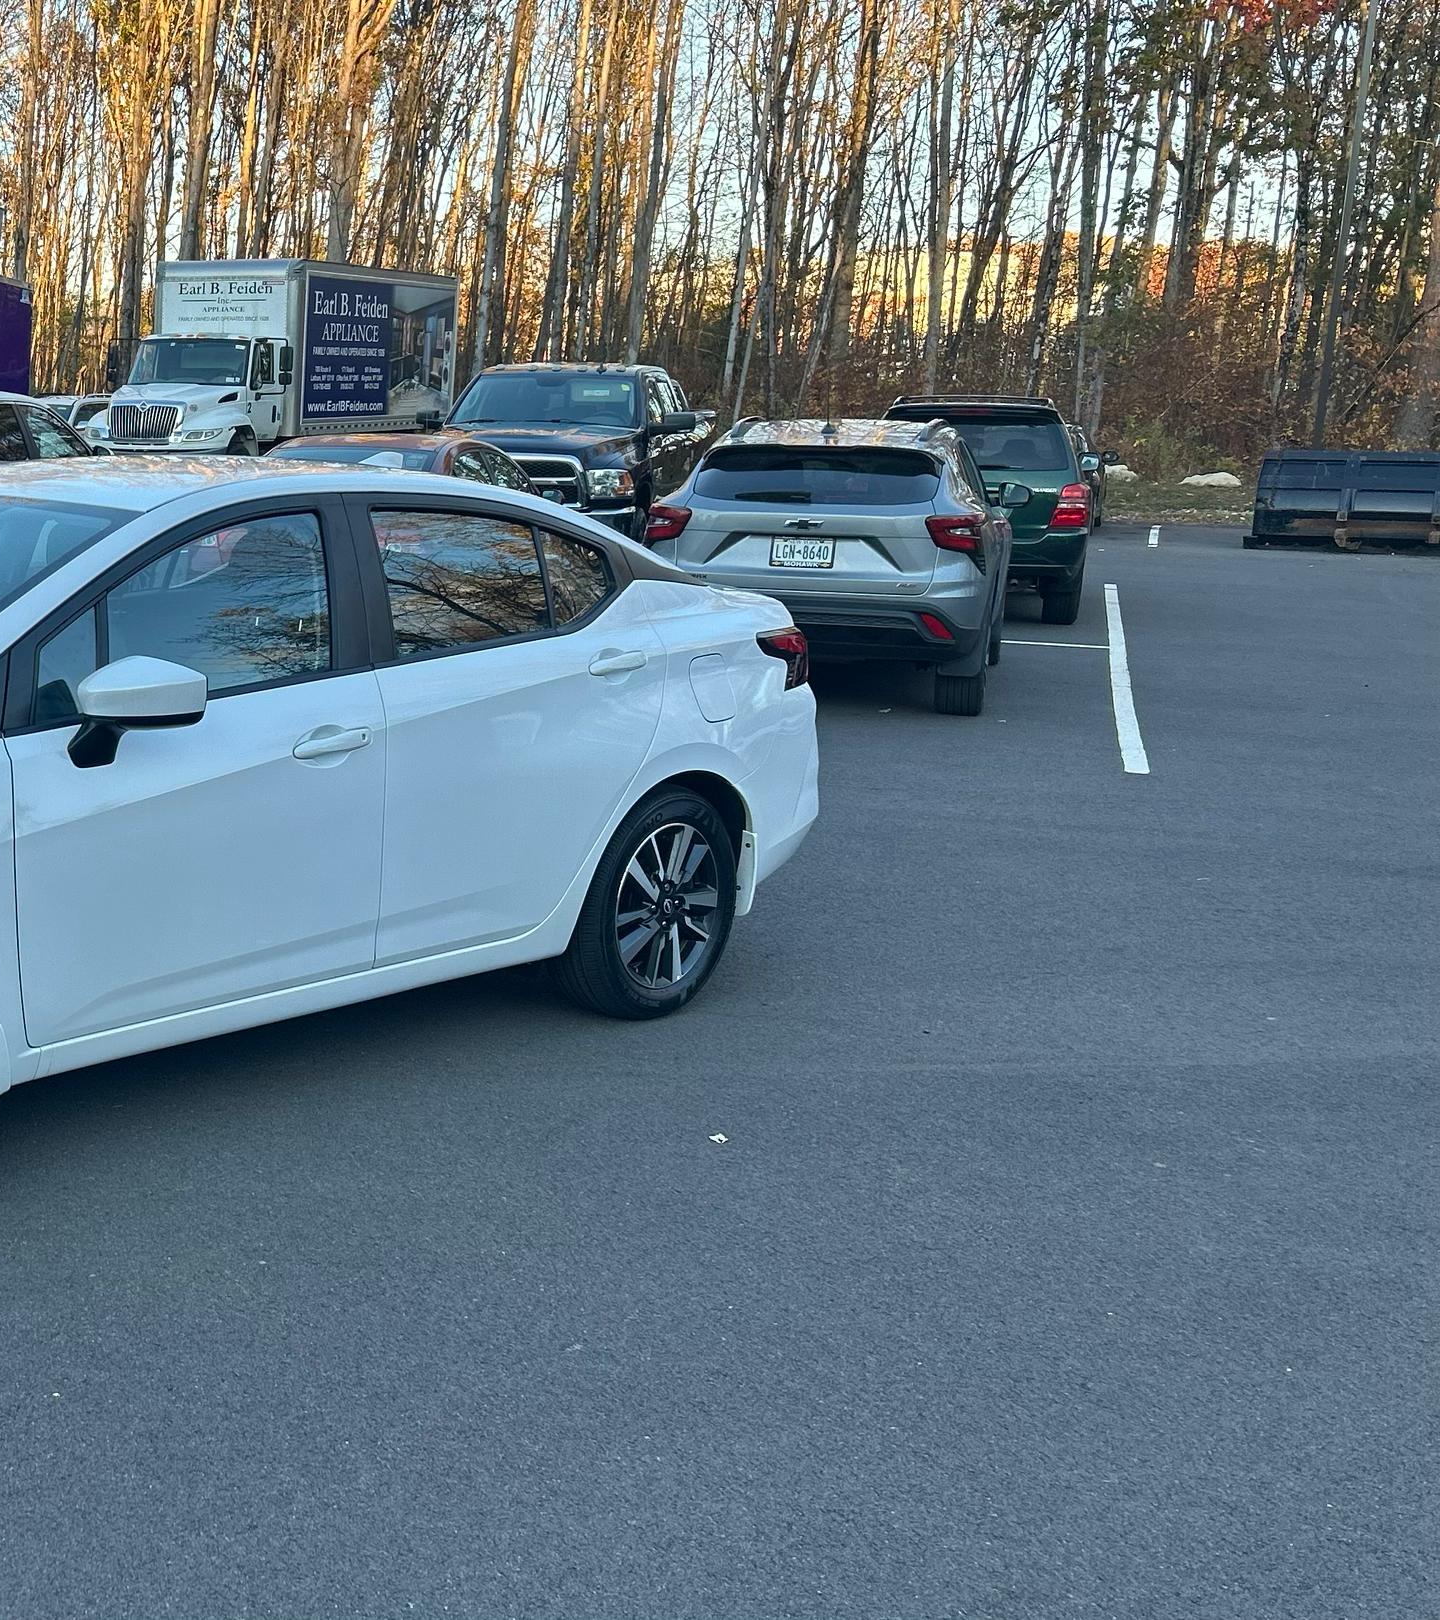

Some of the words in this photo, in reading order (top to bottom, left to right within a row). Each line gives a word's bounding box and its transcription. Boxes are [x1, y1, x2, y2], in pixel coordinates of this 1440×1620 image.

[179, 282, 206, 295] Earl
[211, 282, 223, 295] B.
[229, 281, 273, 295] Feiden
[313, 290, 338, 316] Earl
[340, 292, 352, 316] B.
[354, 294, 388, 319] Feiden
[322, 322, 379, 342] APPLIANCE
[307, 400, 384, 412] www.EarlBFeiden.com
